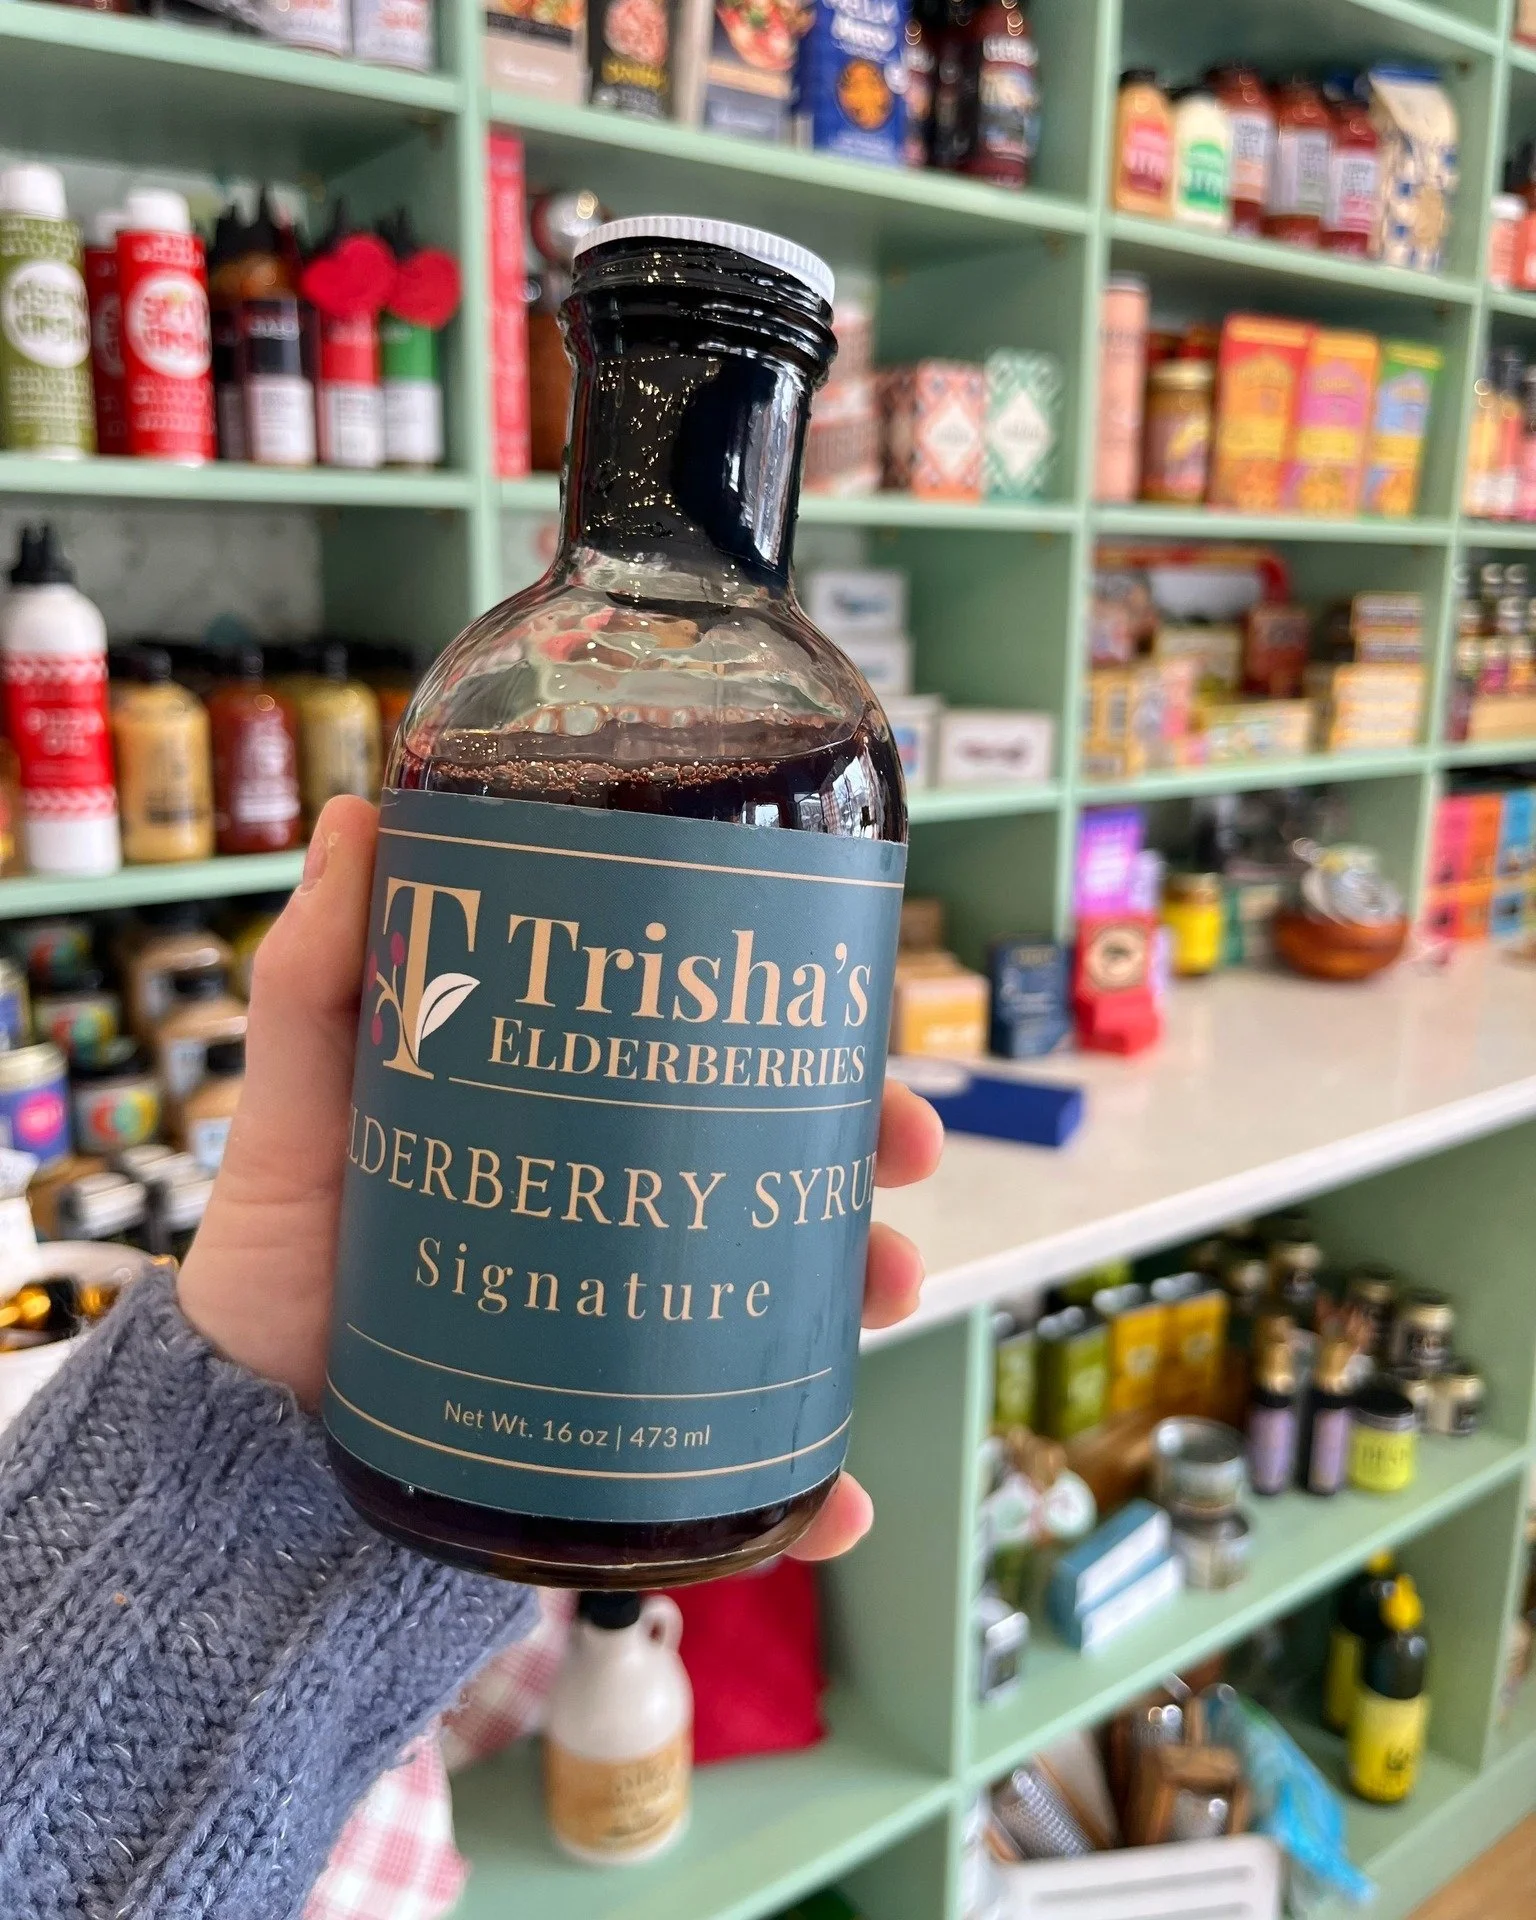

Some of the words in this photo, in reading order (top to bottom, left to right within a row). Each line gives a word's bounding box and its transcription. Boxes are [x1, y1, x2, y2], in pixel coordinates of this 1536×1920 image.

[507, 913, 872, 1028] Trisha's
[488, 1015, 866, 1088] ELDERBERRIES
[347, 1103, 727, 1231] LDERBERRY
[415, 1236, 771, 1321] Signature
[443, 1399, 485, 1430] Net
[491, 1410, 534, 1439] Wt.
[542, 1419, 573, 1444] 16
[578, 1428, 608, 1446] oz
[629, 1426, 678, 1449] 473
[684, 1424, 711, 1447] ml
